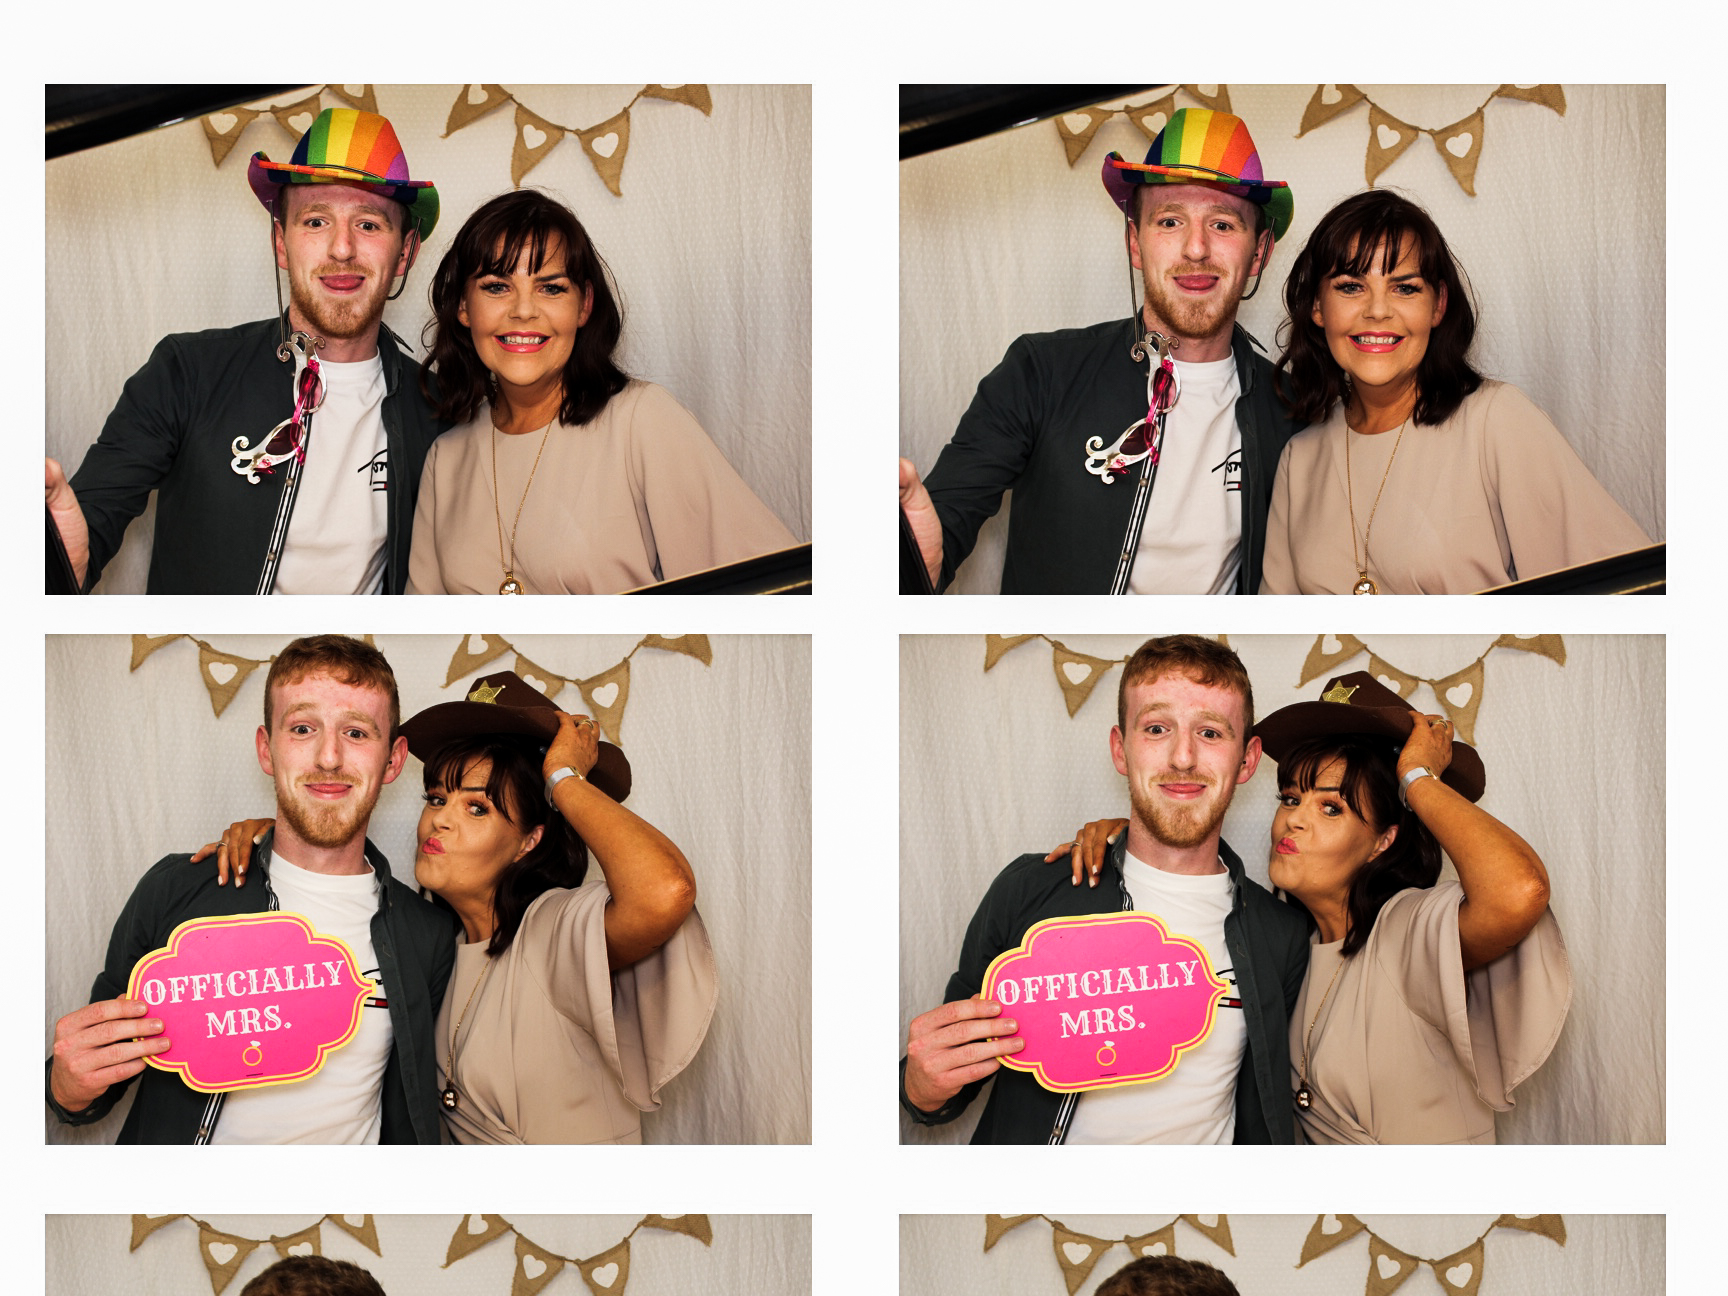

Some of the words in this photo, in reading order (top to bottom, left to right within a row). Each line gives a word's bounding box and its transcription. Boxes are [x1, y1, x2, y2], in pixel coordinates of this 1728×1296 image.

[142, 960, 345, 1006] OFFICIALLY
[996, 960, 1199, 1006] OFFICIALLY
[205, 1005, 292, 1038] MRS.
[1059, 1005, 1146, 1038] MRS.
